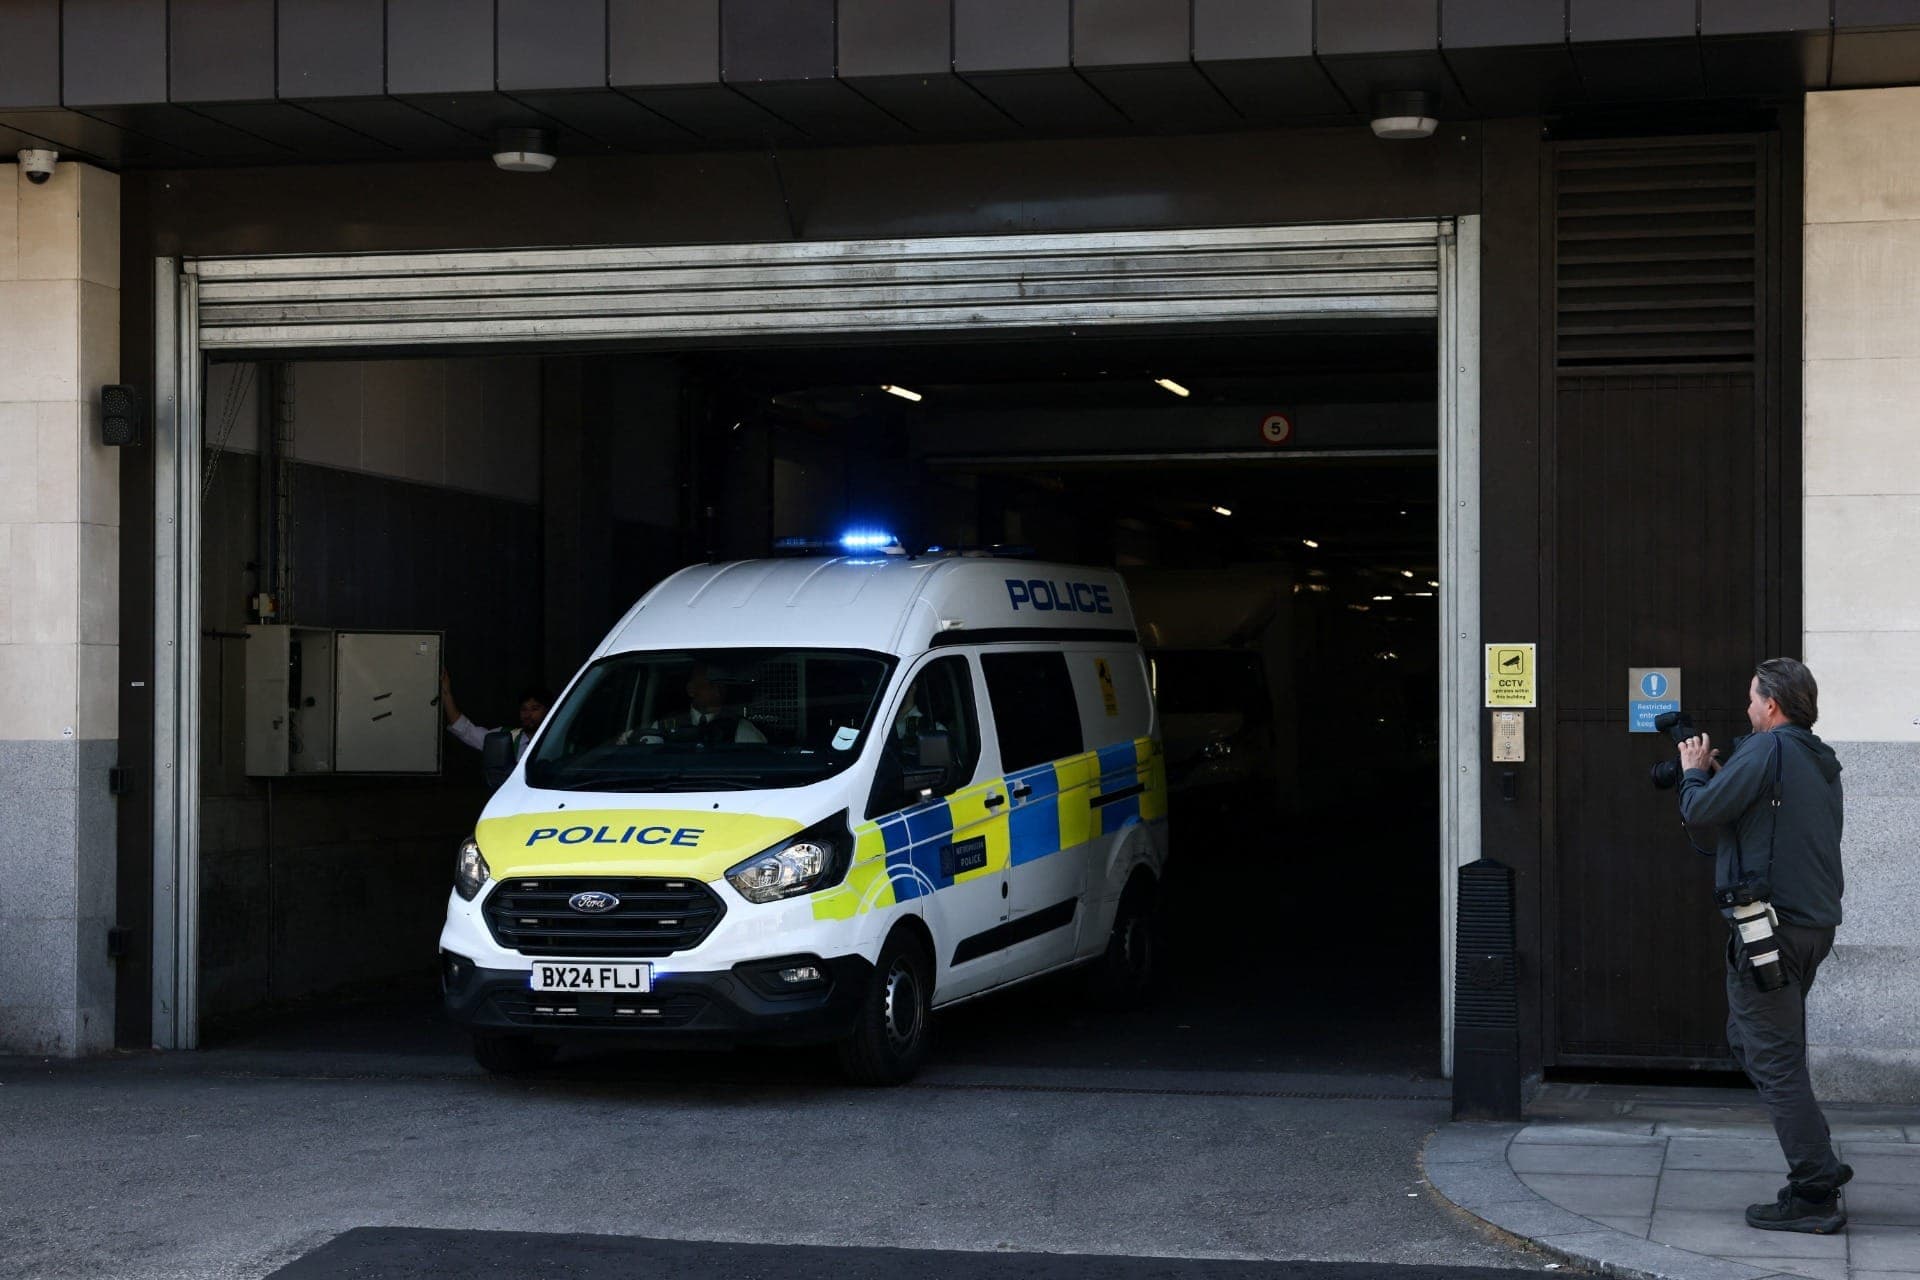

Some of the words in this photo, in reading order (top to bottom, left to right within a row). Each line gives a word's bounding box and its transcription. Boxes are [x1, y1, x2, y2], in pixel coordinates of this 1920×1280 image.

[1271, 422, 1281, 436] 5
[1005, 579, 1113, 614] POLICE
[1498, 679, 1524, 687] CCTV
[525, 825, 705, 847] POLICE
[960, 853, 982, 867] POLICE
[577, 895, 607, 909] Ford
[542, 967, 594, 988] BX24
[600, 967, 640, 988] FLJ
